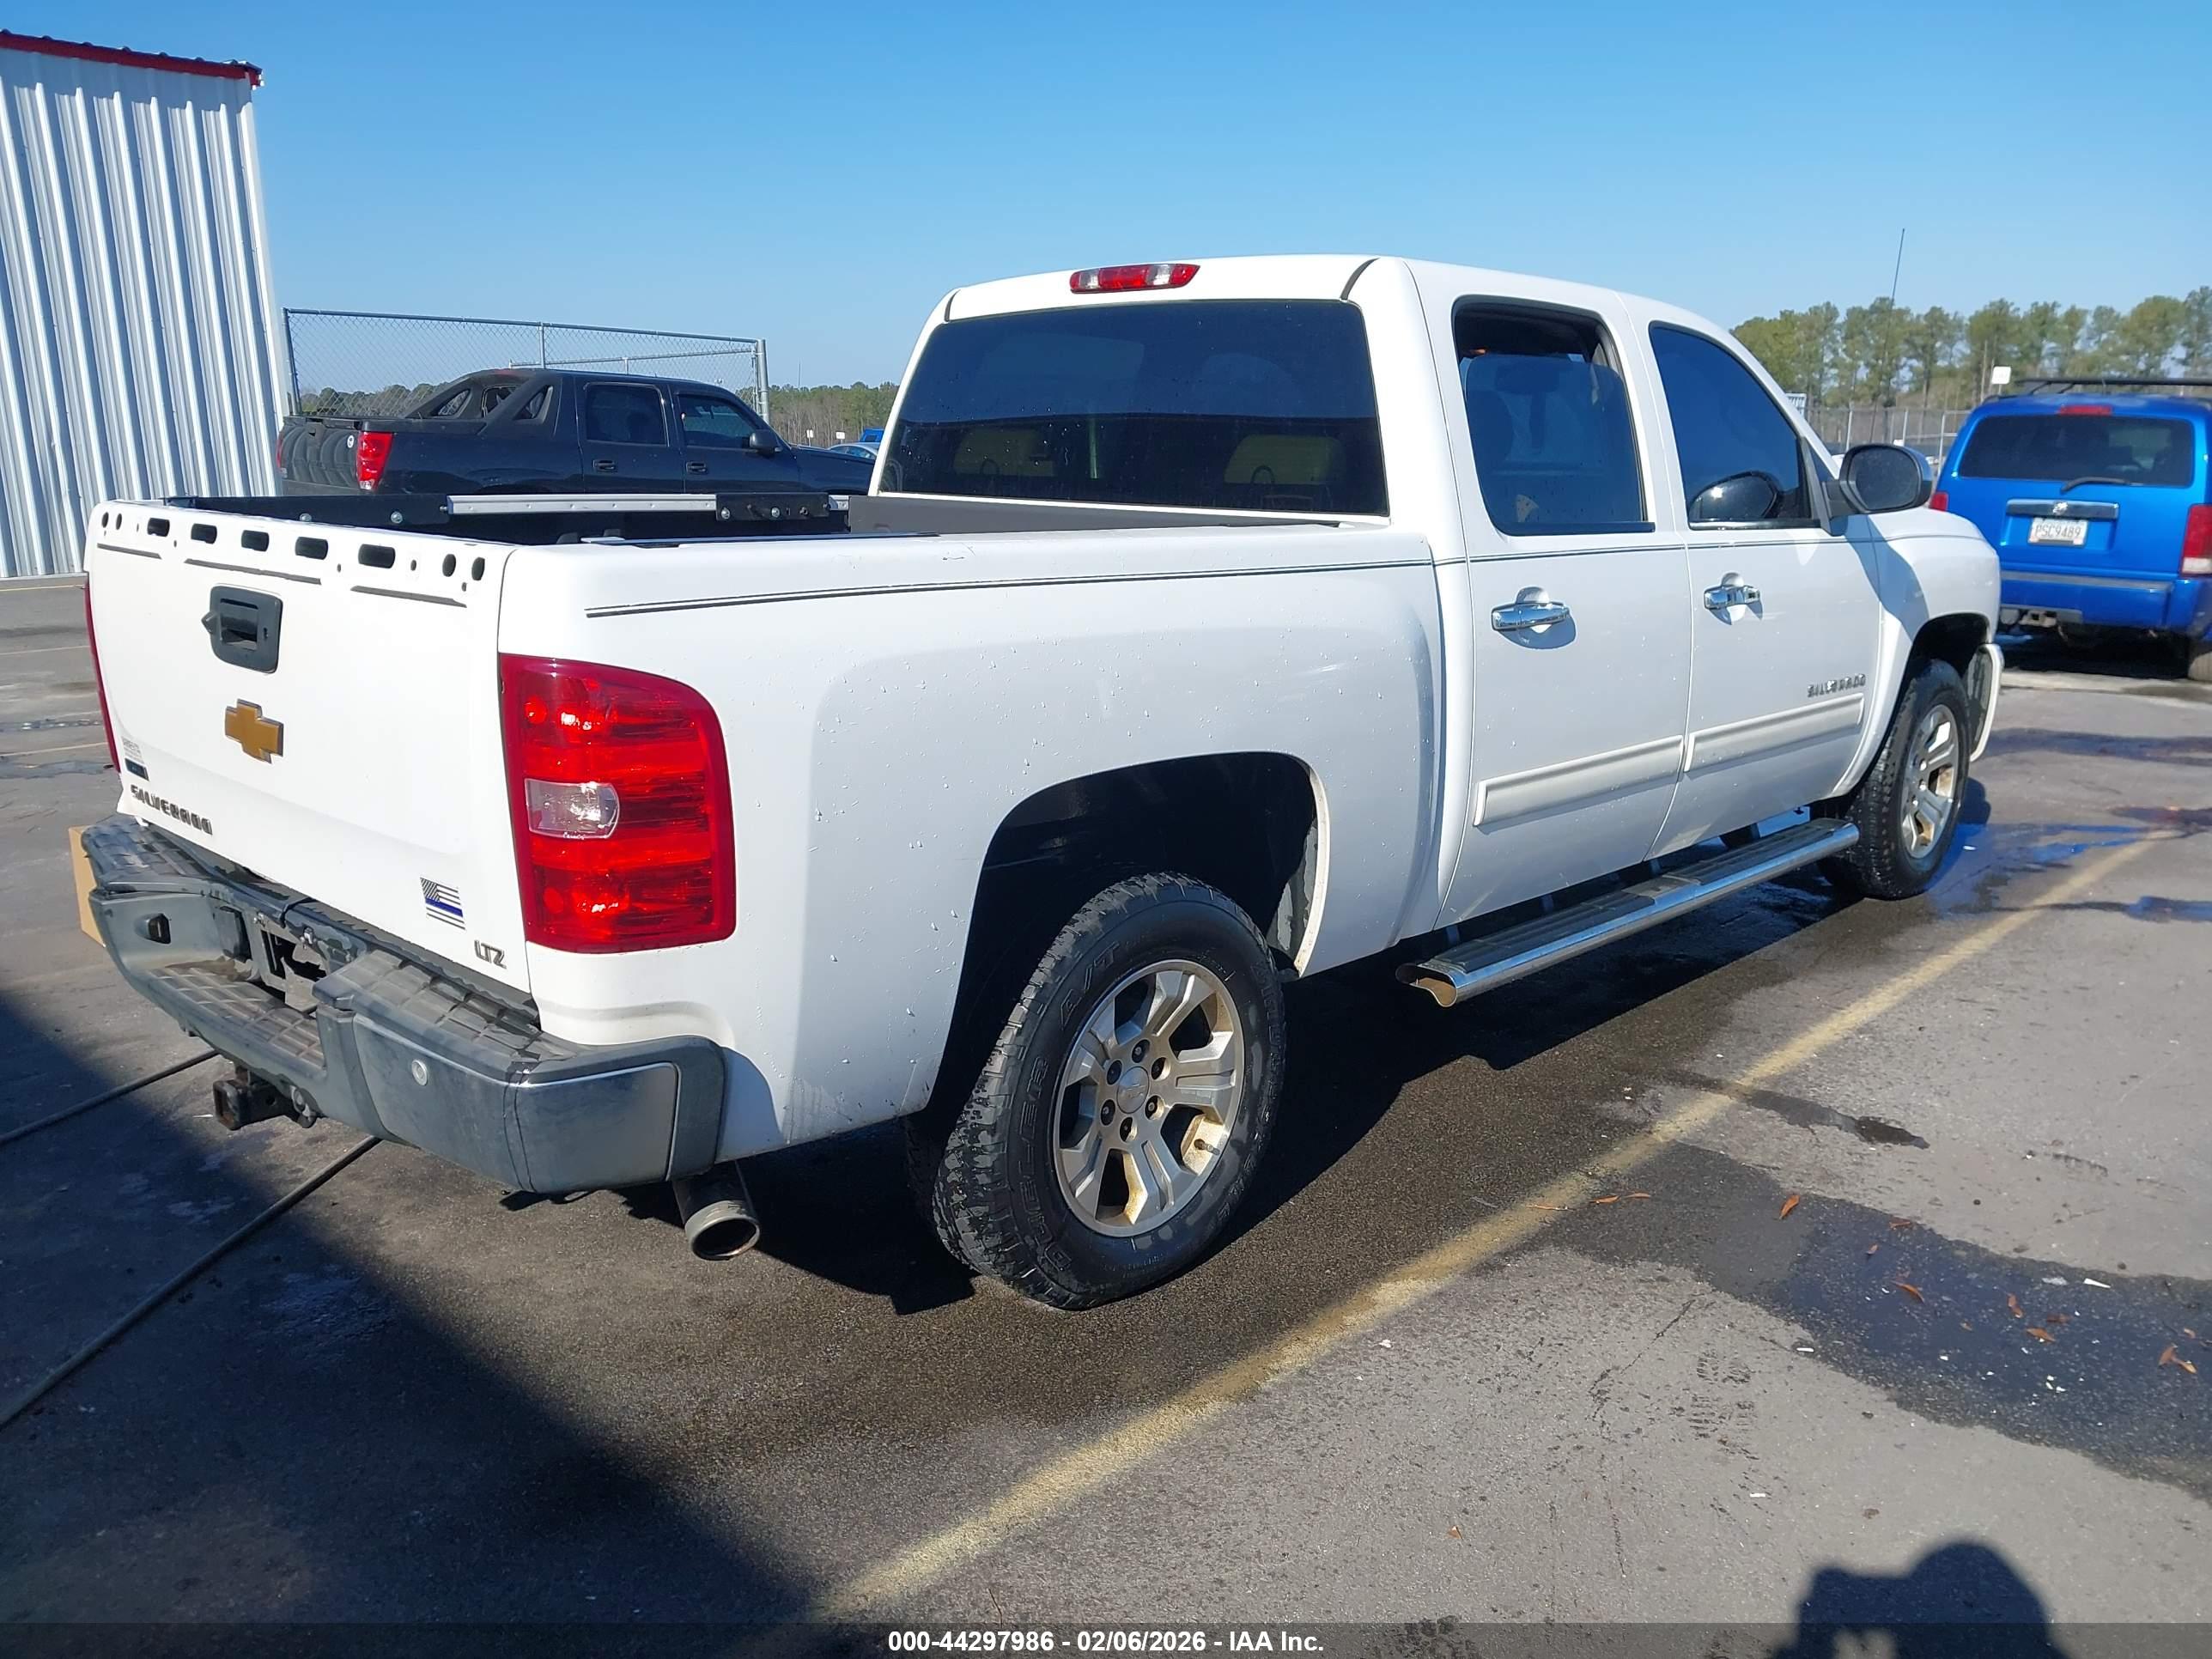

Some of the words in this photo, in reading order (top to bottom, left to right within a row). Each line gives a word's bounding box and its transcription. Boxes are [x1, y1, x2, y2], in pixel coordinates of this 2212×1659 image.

[2035, 524, 2082, 538] PSC9489
[1807, 673, 1866, 697] SILVERADO
[130, 784, 213, 836] SILVERADO
[474, 939, 507, 969] LTZ
[1060, 941, 1120, 1031] A/T
